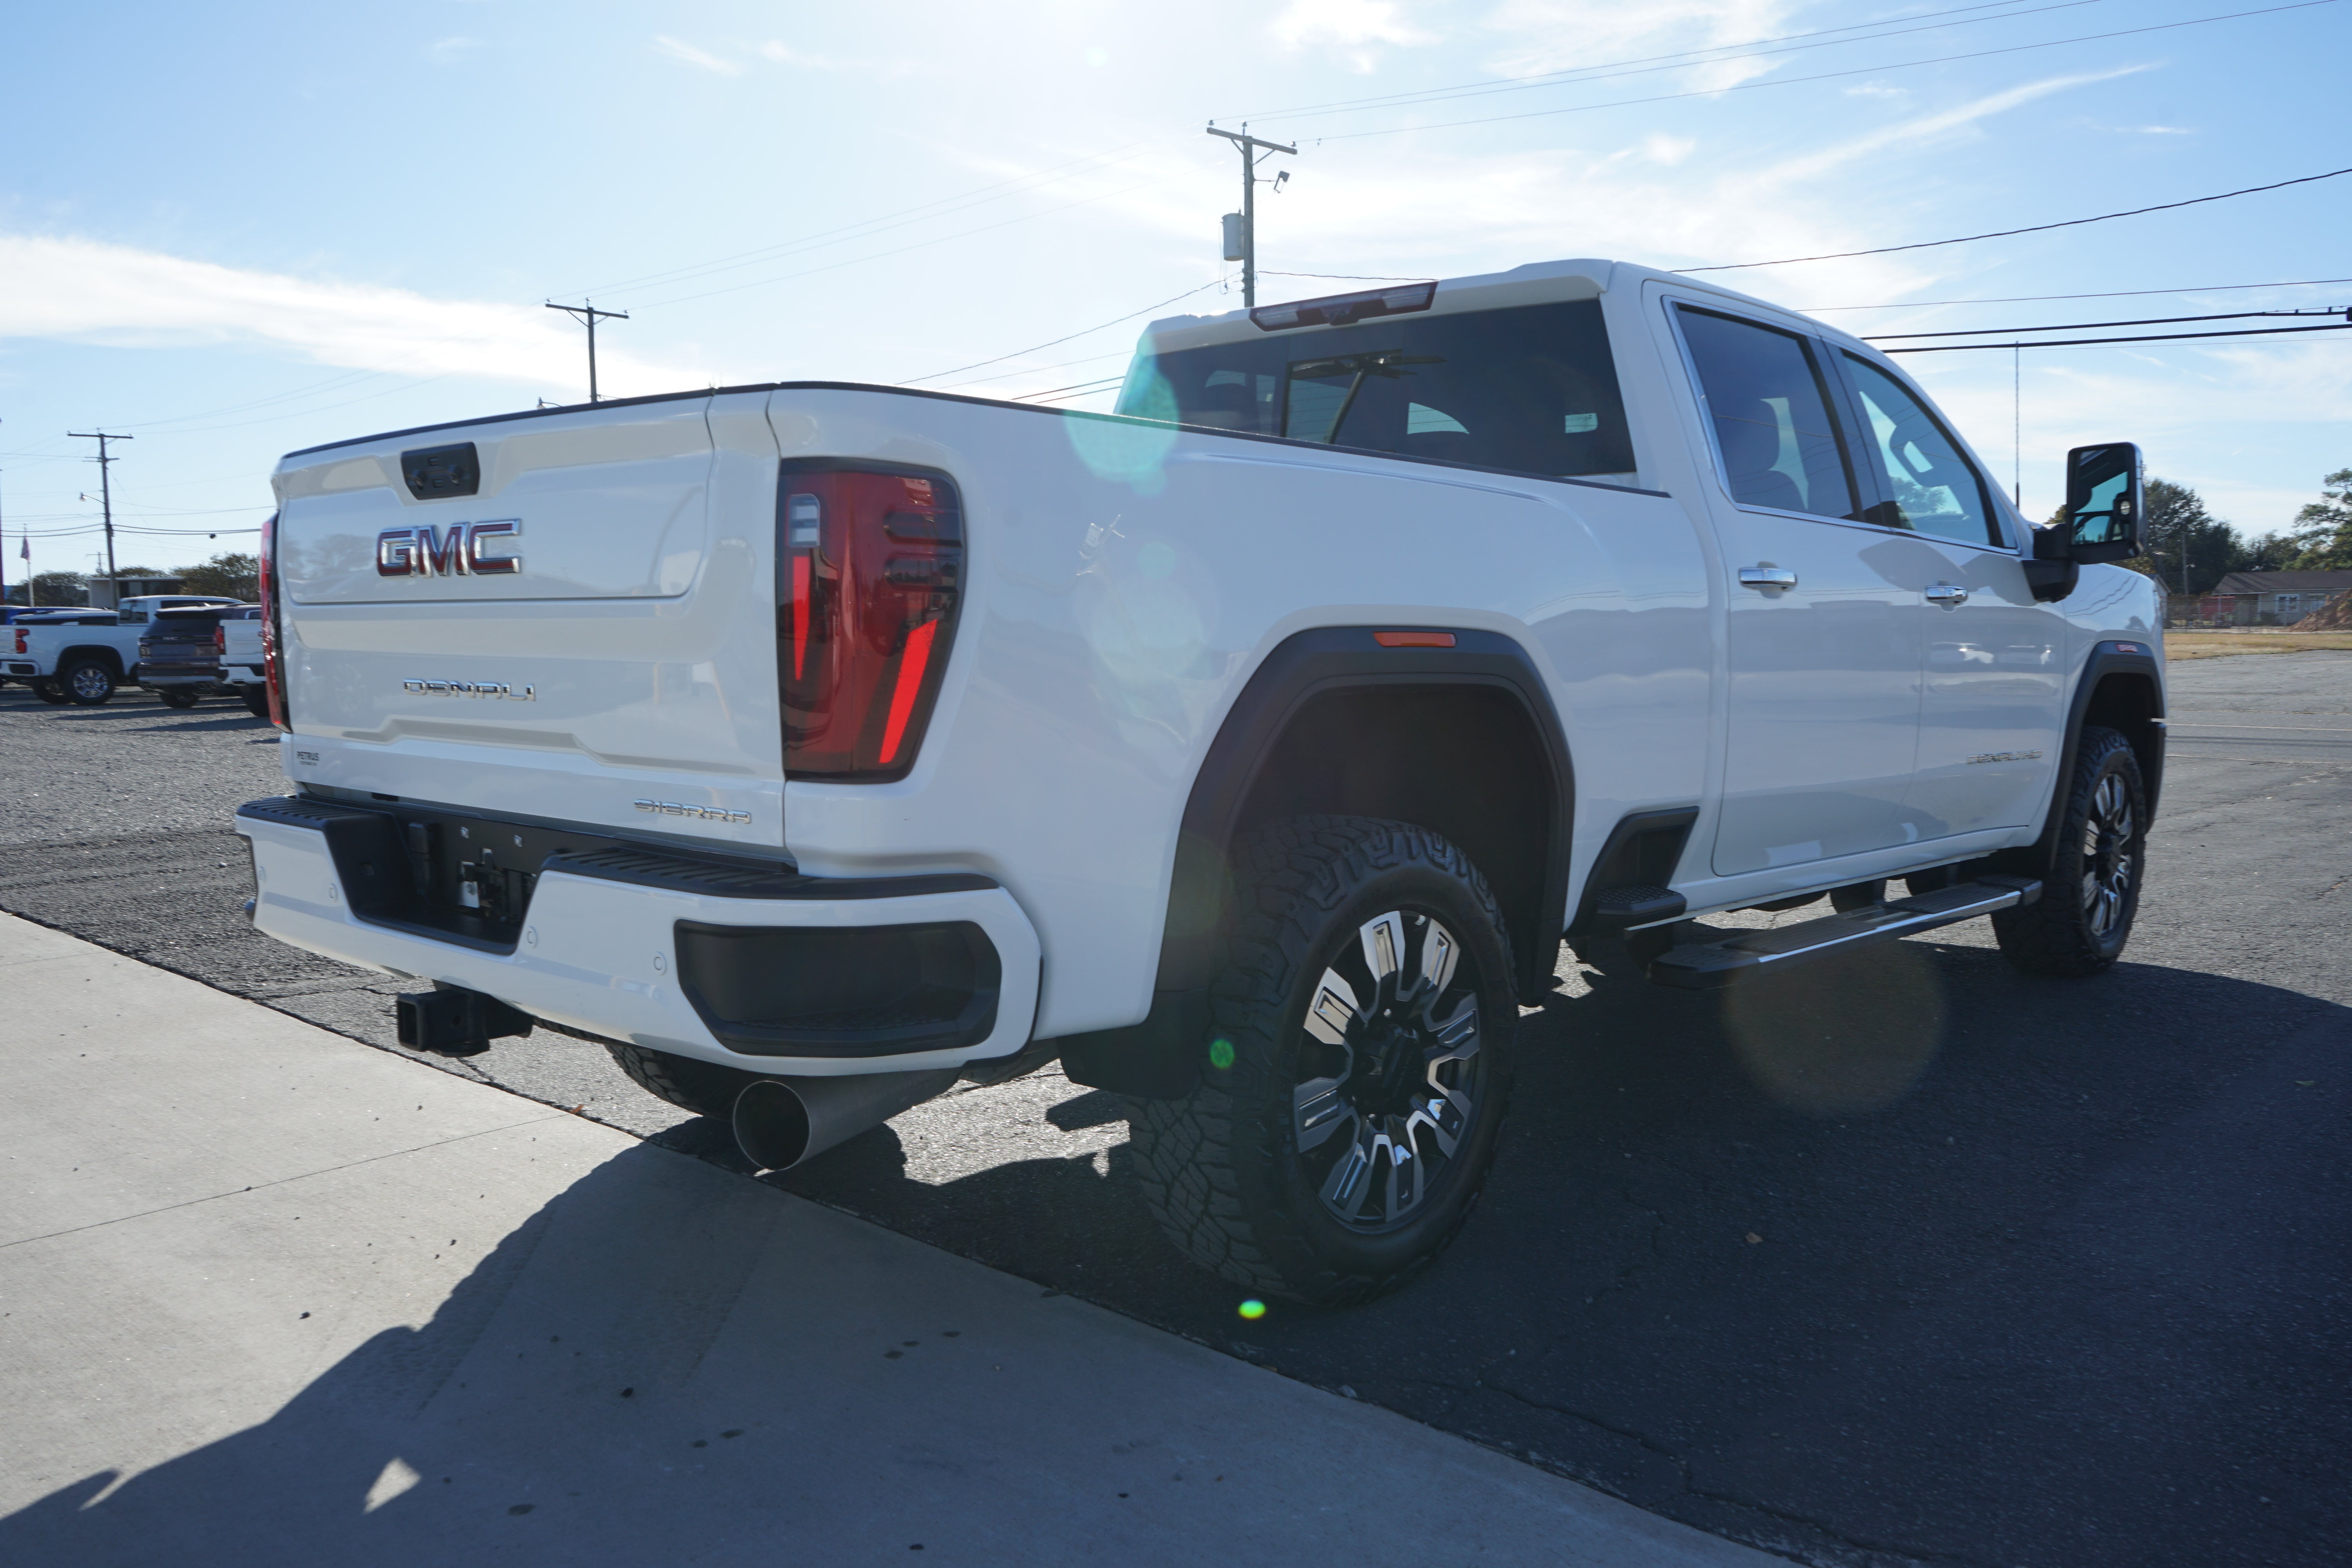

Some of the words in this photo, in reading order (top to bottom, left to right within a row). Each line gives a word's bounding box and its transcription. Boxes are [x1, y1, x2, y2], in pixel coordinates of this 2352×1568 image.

[377, 519, 523, 577] GMC
[403, 678, 536, 701] DENALI
[633, 799, 752, 824] SIERRA
